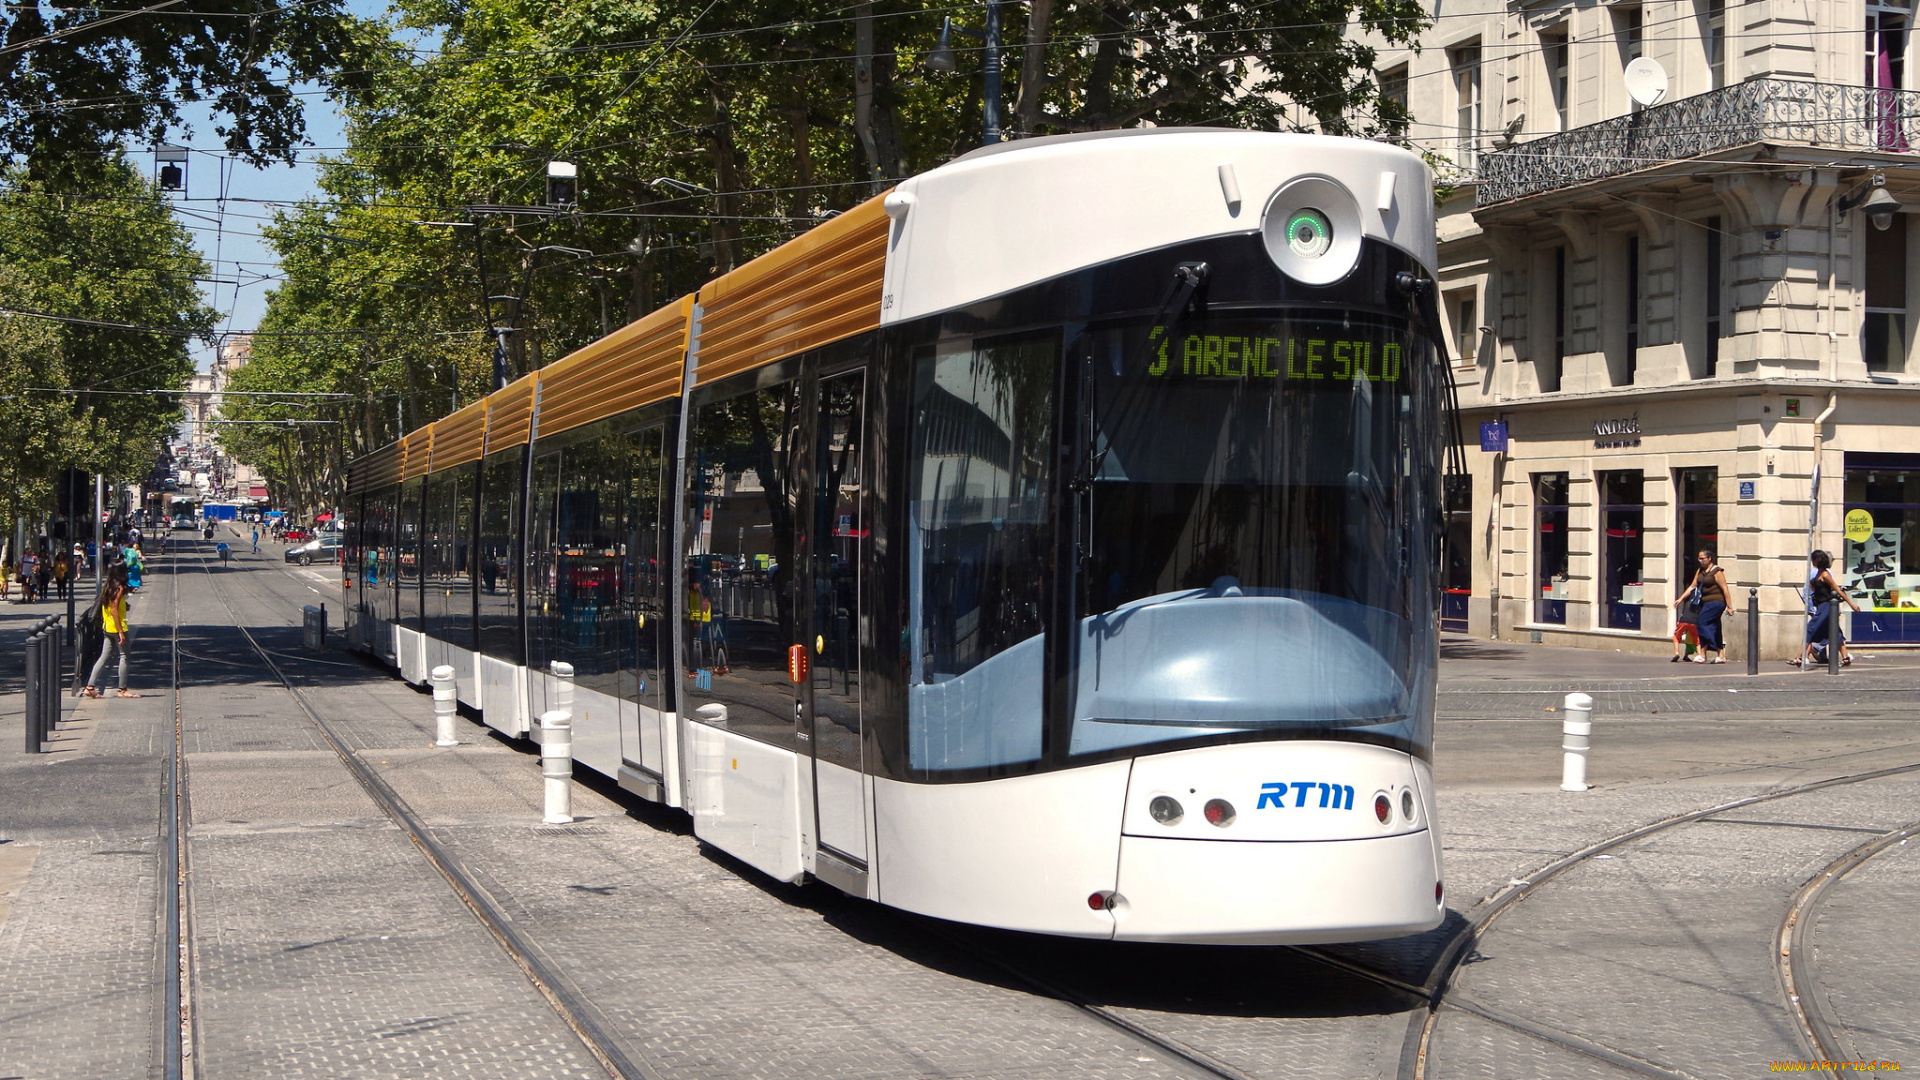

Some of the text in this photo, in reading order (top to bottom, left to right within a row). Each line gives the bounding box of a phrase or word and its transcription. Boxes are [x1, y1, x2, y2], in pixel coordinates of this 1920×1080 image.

[1148, 325, 1401, 382] 3 ARENC LE SILO
[1592, 411, 1643, 436] ANDRÉ
